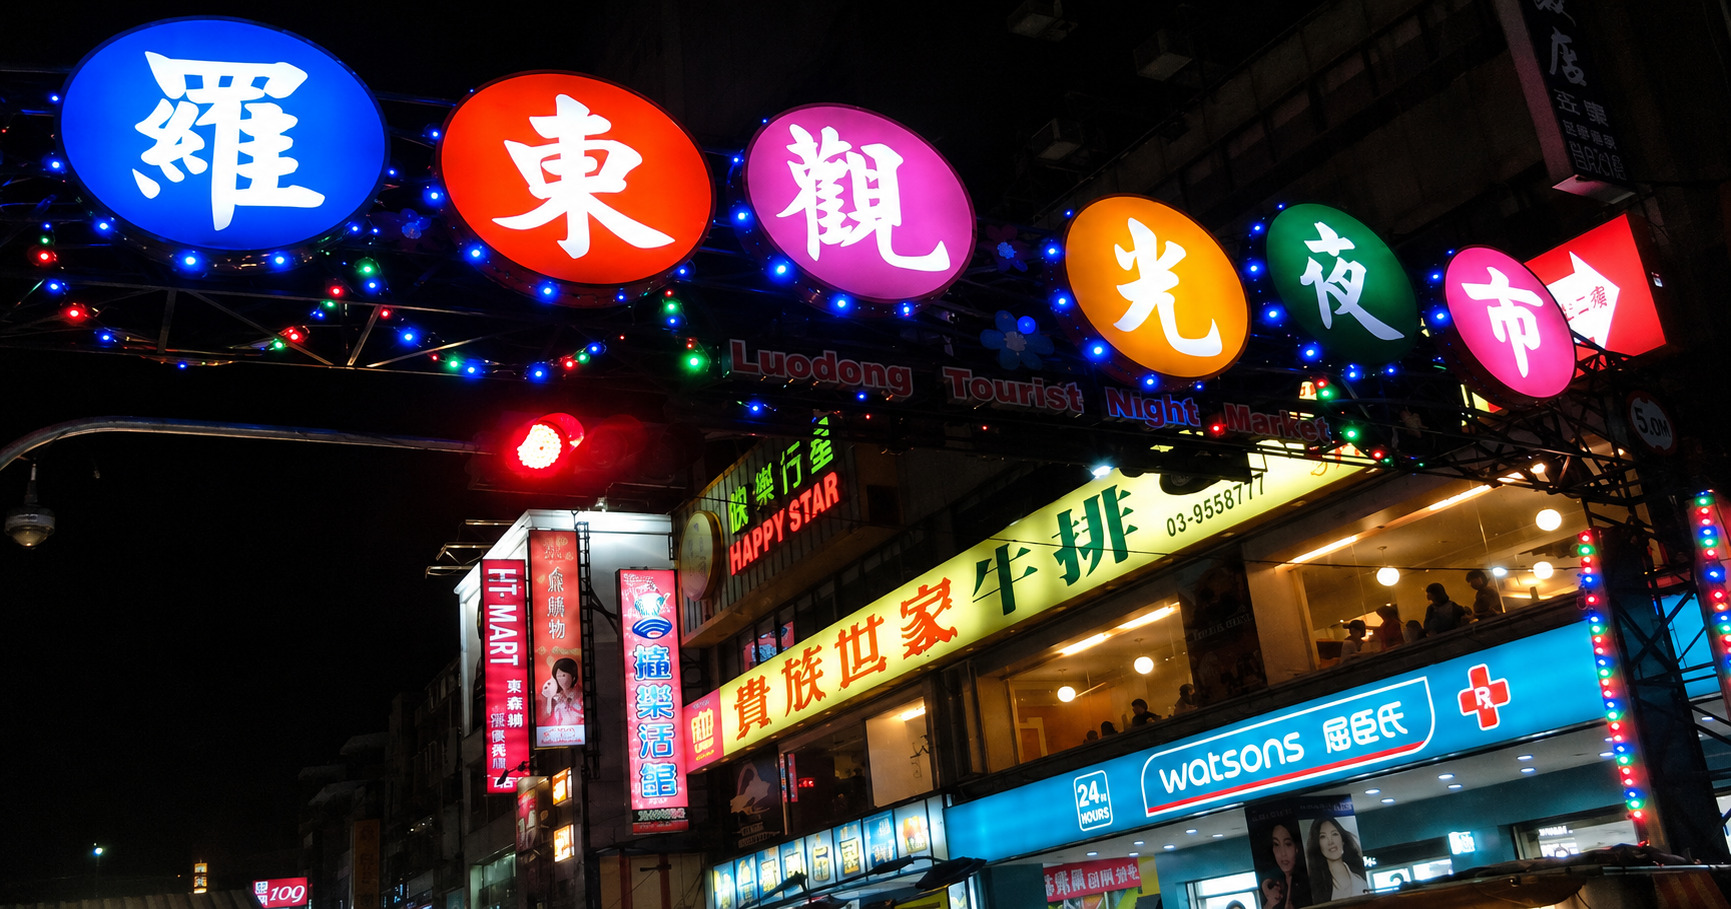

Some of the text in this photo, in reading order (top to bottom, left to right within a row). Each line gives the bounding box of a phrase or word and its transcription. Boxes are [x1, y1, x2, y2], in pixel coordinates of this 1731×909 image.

[132, 51, 1543, 378] 羅 東 觀 光 夜 市
[729, 338, 1332, 446] Luodong Tourist Night Market
[729, 508, 785, 577] HAPPY
[789, 471, 839, 533] STAR
[1166, 473, 1265, 538] 03-9558777
[488, 604, 519, 667] MART
[1322, 700, 1409, 755] 屈臣氏
[1159, 731, 1304, 795] watsons
[1081, 806, 1110, 825] HOURS
[269, 884, 306, 904] 109
